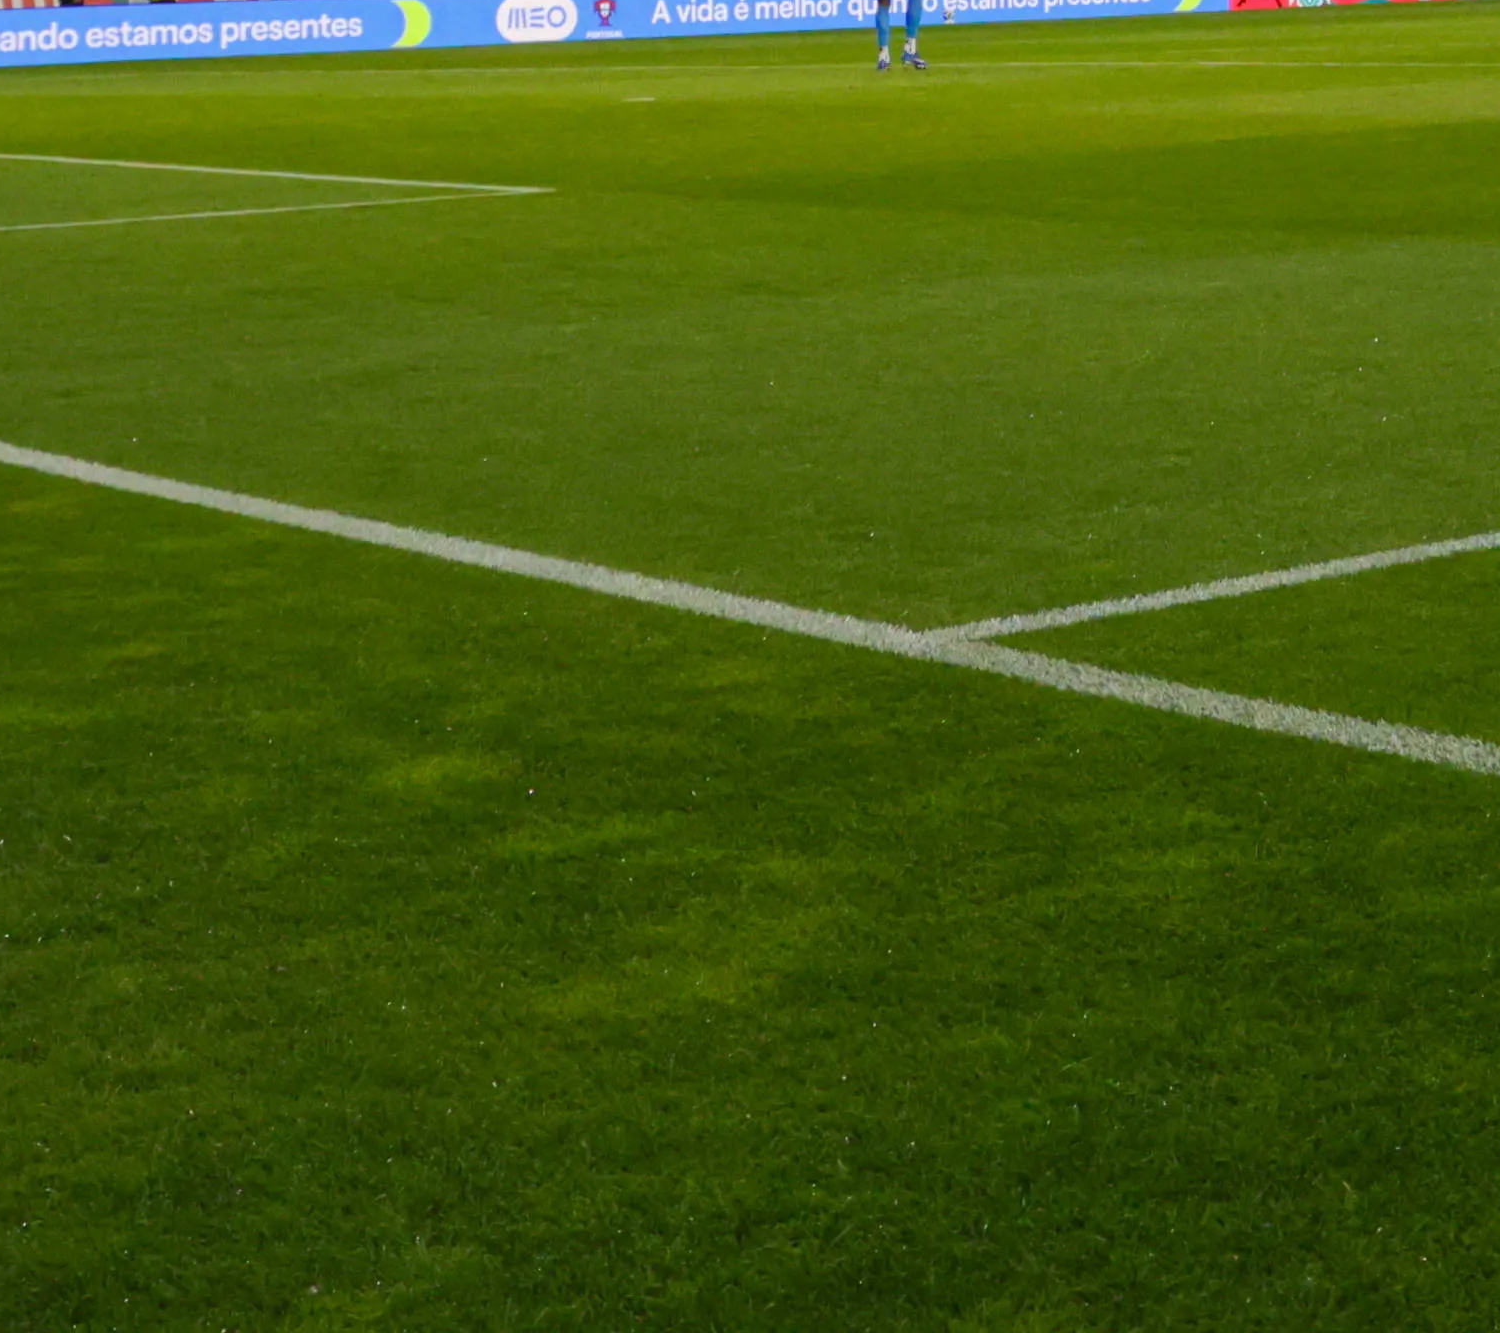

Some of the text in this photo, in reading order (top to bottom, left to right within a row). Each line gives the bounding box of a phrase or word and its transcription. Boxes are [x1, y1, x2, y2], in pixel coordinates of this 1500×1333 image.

[507, 6, 567, 29] MEO
[652, 0, 671, 24] A
[86, 21, 213, 48] estamos
[220, 13, 363, 49] presentes
